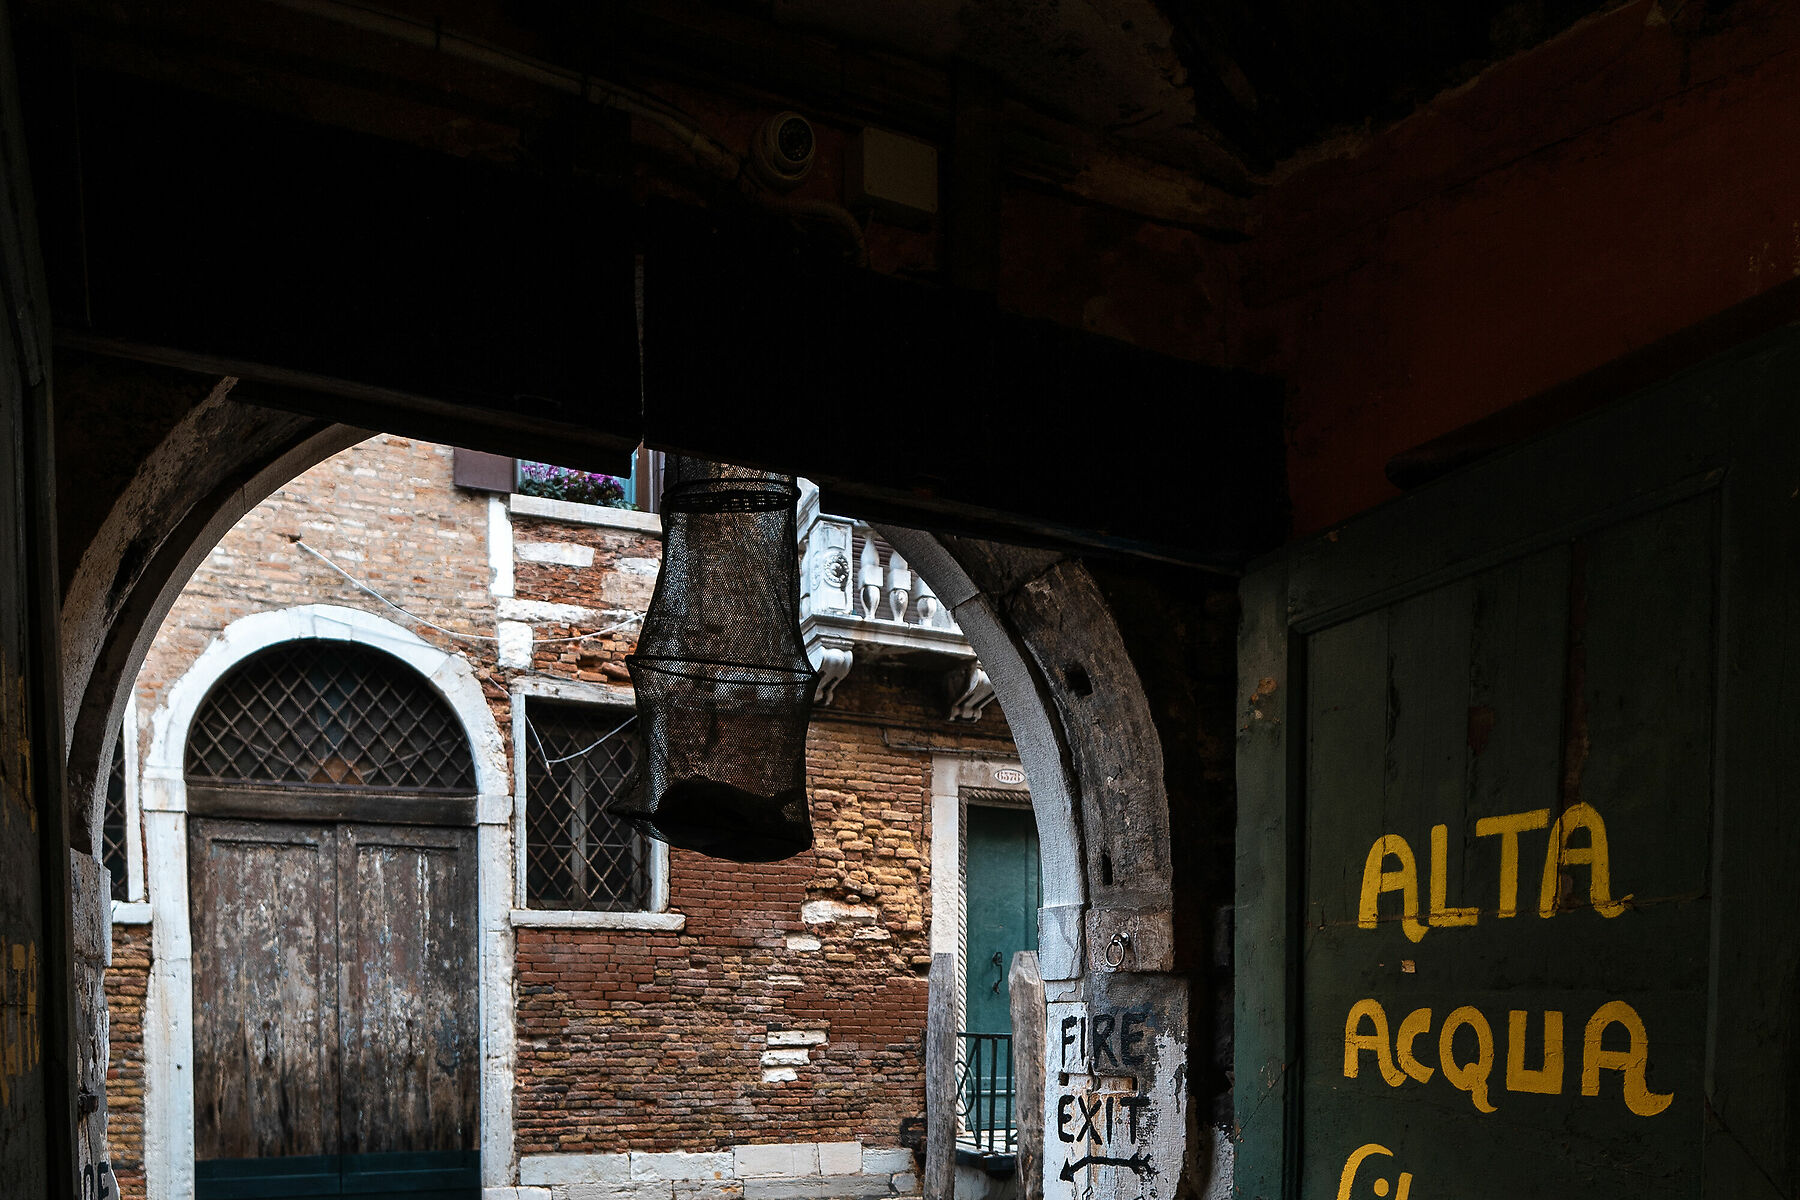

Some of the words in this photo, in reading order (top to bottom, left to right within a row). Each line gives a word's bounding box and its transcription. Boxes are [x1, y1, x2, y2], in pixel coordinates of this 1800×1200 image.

[1357, 801, 1635, 943] ALTA
[1060, 1012, 1147, 1070] FIRE
[1343, 998, 1675, 1117] ACQUA
[1057, 1093, 1150, 1148] EXIT
